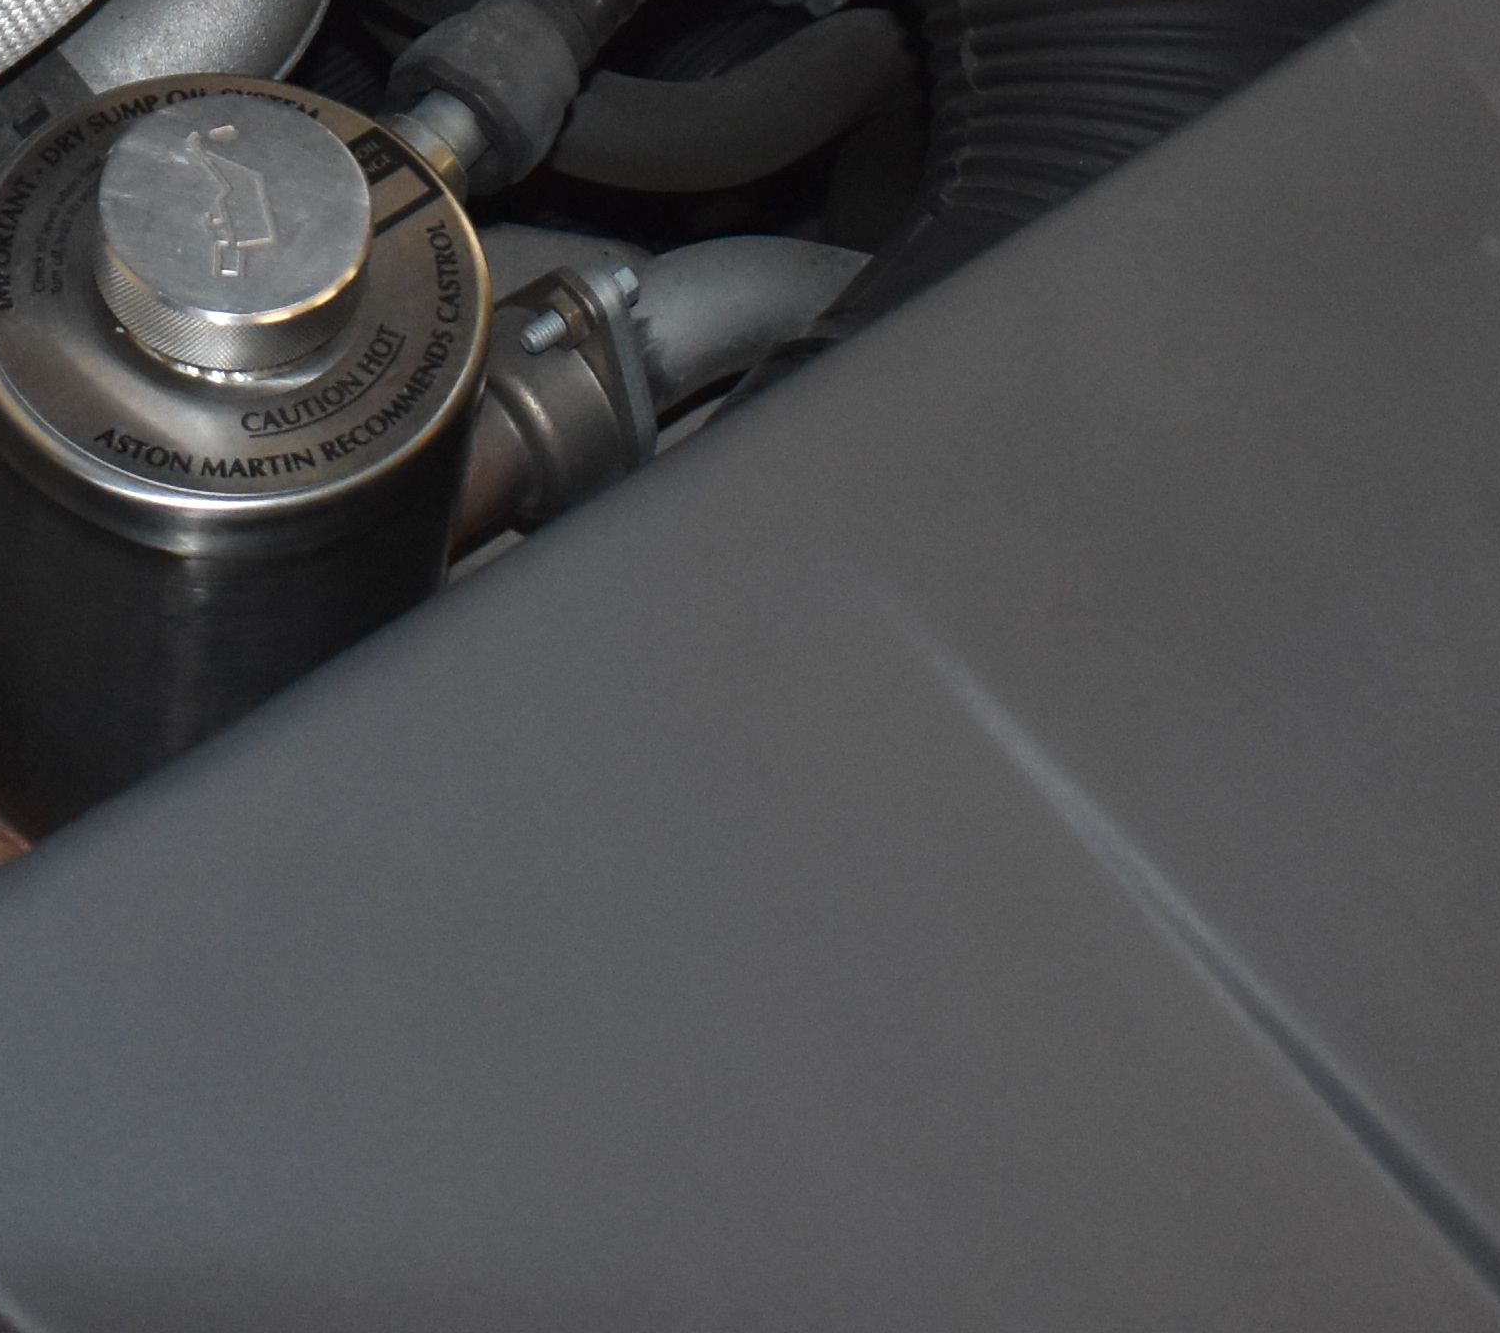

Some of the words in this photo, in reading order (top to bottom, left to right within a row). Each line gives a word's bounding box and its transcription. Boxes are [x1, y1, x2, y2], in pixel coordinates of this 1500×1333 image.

[41, 126, 86, 166] DRY
[87, 94, 159, 133] SUMP
[94, 428, 193, 474] ASTON
[199, 448, 317, 478] MARTIN
[319, 327, 454, 461] RECOMMENDS
[425, 220, 461, 324] CASTROL
[241, 370, 364, 434] CAUTION
[358, 324, 398, 377] HOT
